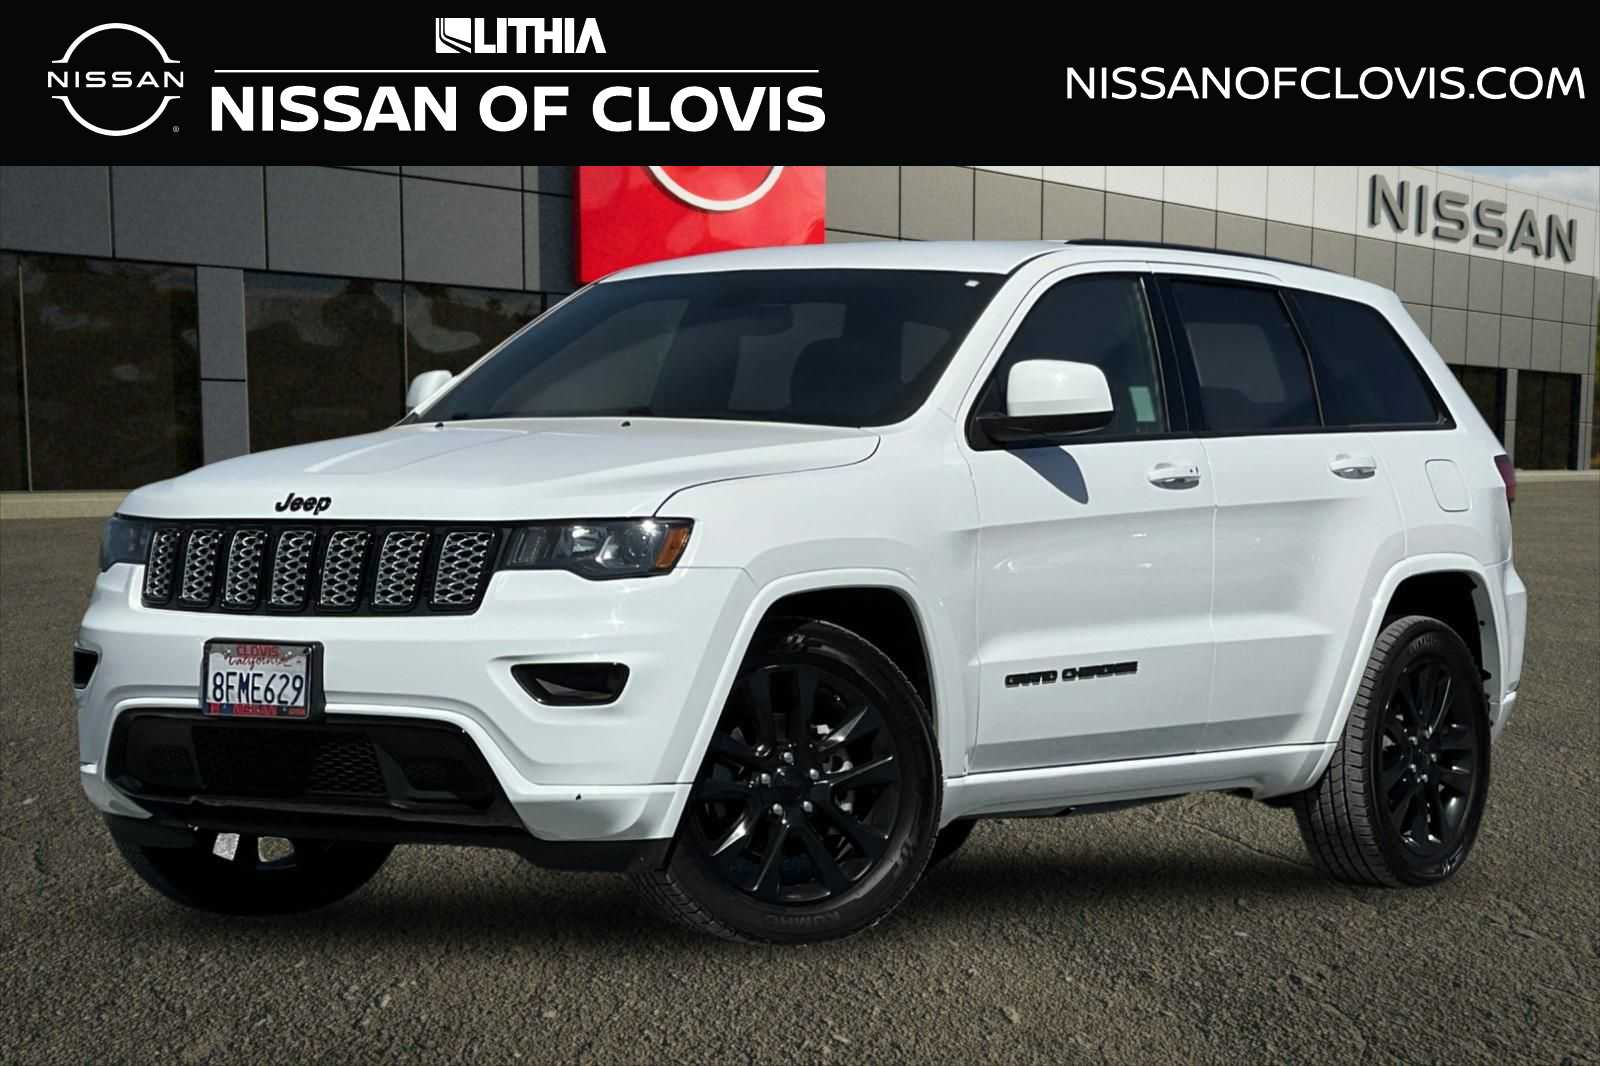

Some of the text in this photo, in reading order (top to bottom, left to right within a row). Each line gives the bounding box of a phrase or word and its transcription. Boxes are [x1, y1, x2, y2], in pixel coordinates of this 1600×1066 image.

[1368, 174, 1577, 262] NISSAN
[275, 492, 332, 515] Jeep
[212, 671, 304, 705] 8FME629
